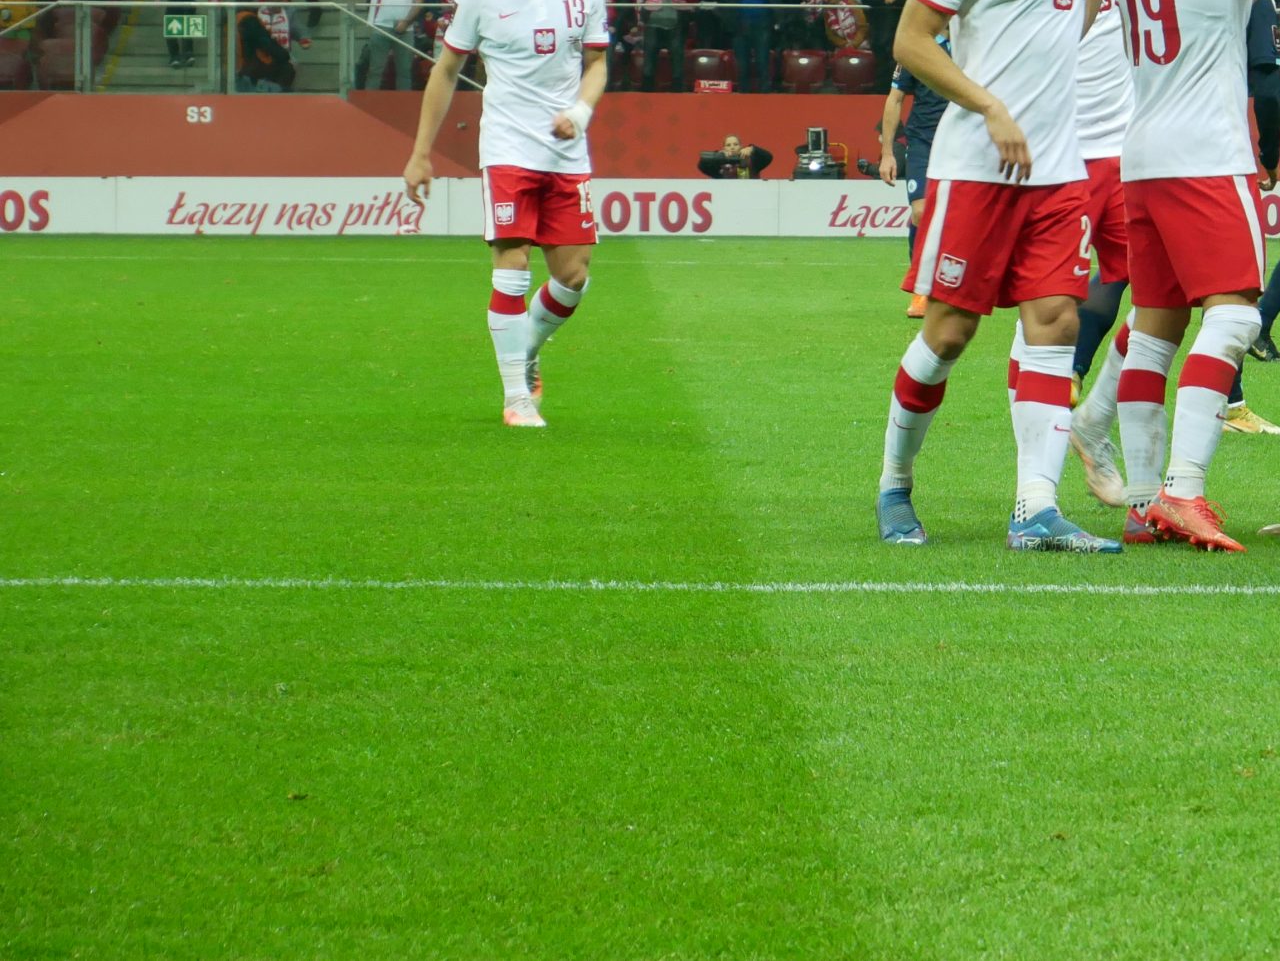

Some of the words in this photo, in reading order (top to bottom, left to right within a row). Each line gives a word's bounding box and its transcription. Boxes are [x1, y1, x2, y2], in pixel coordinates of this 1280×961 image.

[187, 106, 212, 123] S3
[165, 191, 269, 235] Łączy
[273, 202, 337, 231] nas
[336, 191, 425, 235] piłka
[597, 191, 712, 232] OTOS
[828, 194, 911, 237] Łącz
